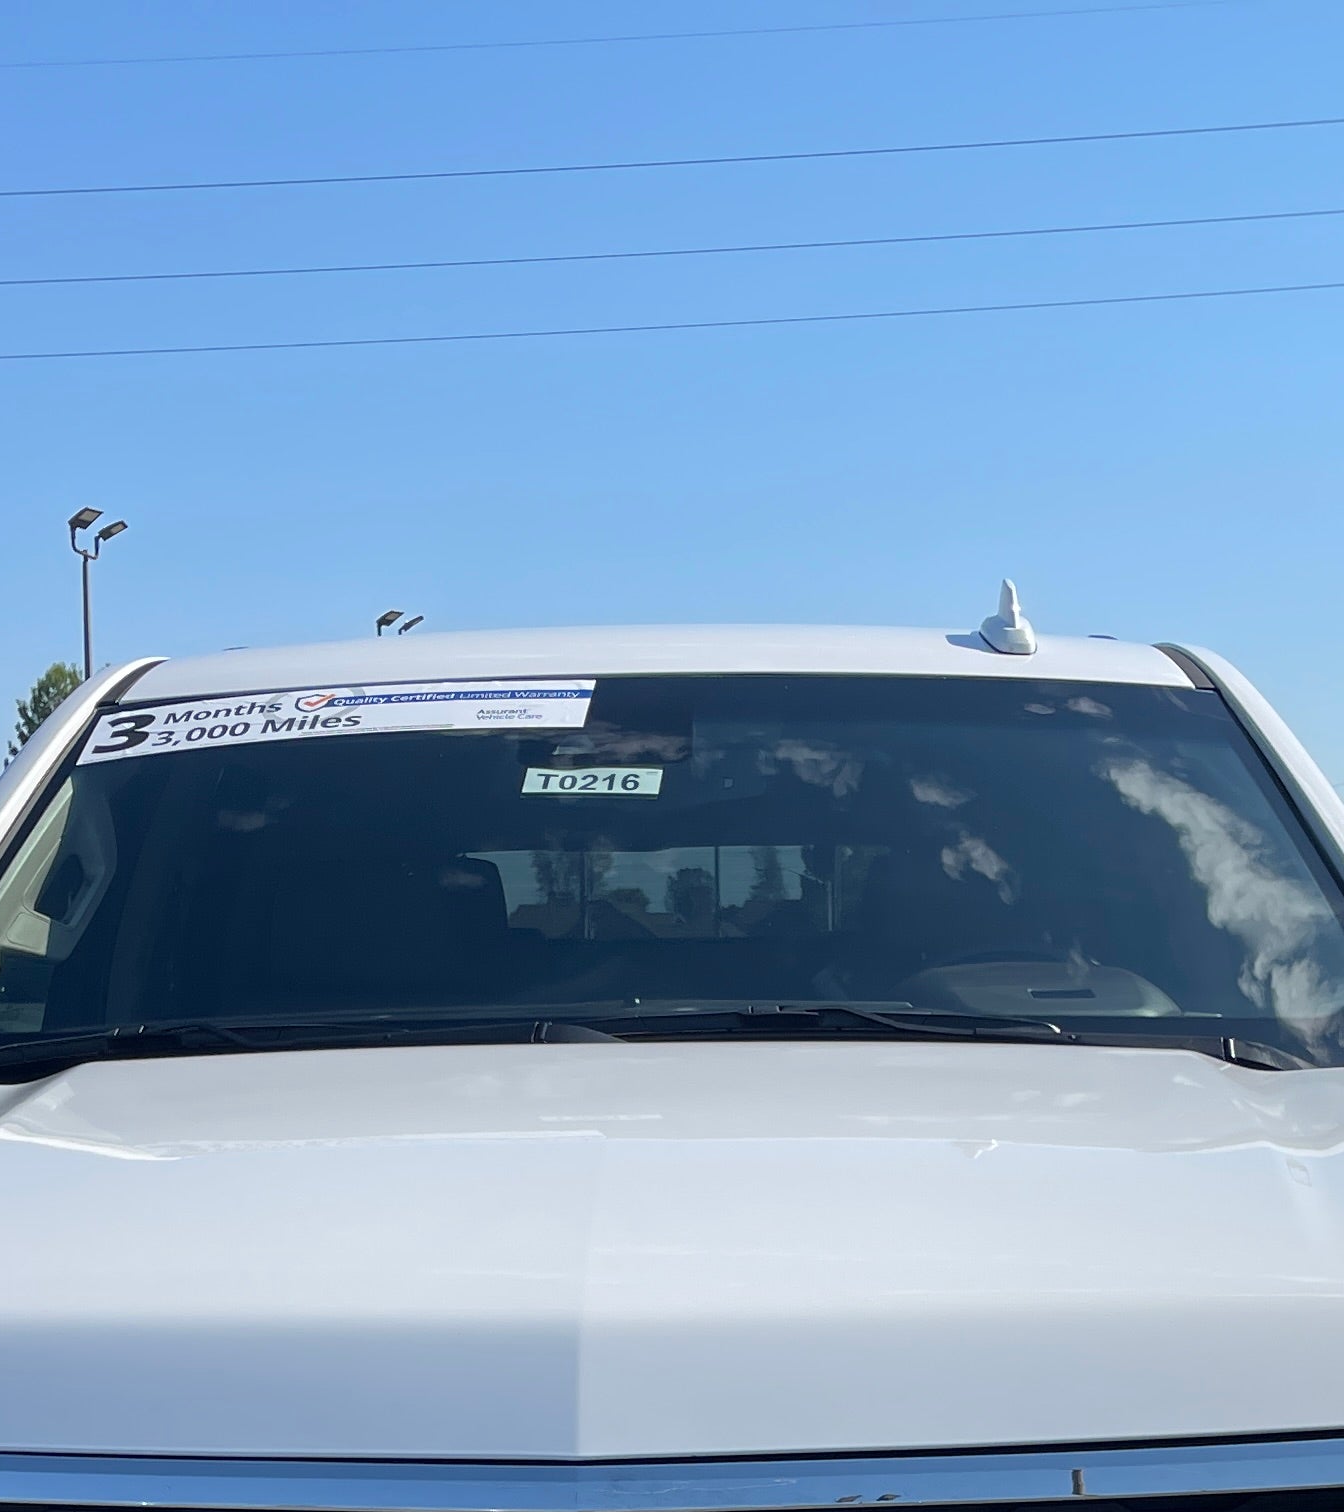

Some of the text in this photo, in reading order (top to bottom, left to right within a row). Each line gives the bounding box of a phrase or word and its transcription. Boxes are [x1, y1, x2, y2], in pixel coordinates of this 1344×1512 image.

[334, 690, 581, 707] Quality Certified Limited Warranty
[91, 701, 283, 754] 3 Months
[151, 721, 252, 748] 3,000
[259, 713, 363, 735] Miles
[537, 773, 641, 791] T0216
